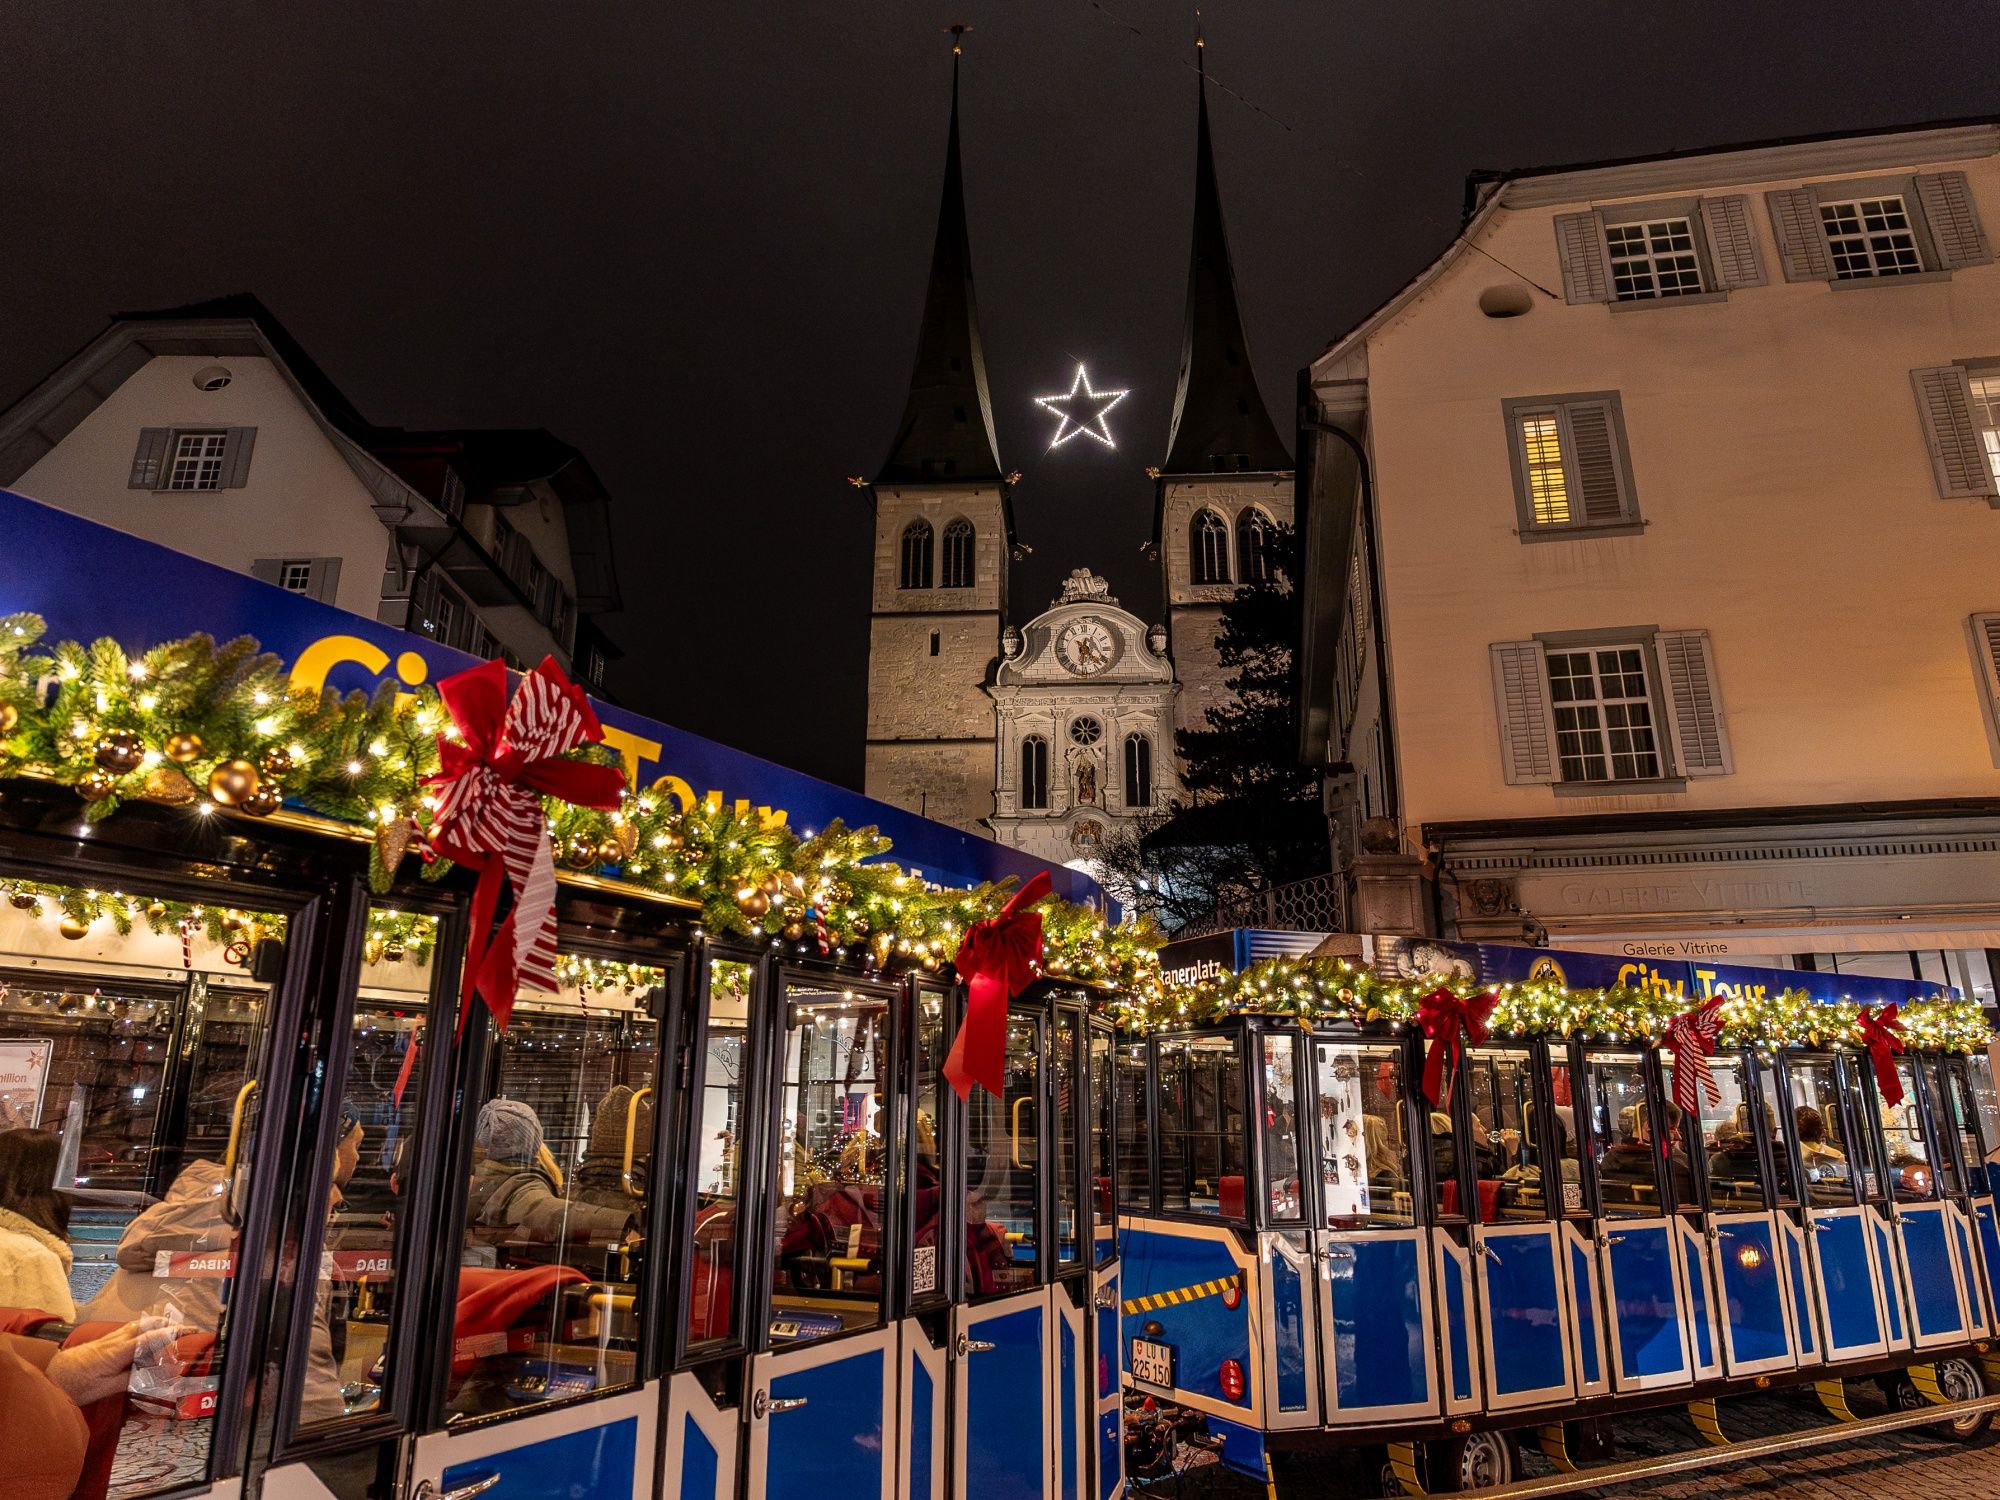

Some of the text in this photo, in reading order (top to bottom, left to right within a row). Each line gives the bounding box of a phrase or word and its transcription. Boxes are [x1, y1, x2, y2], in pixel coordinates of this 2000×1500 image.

[1622, 941, 1729, 957] Galerie Vitrine
[1617, 962, 1766, 1001] City Tour
[1146, 1343, 1156, 1359] LU
[1133, 1358, 1170, 1385] 225 150
